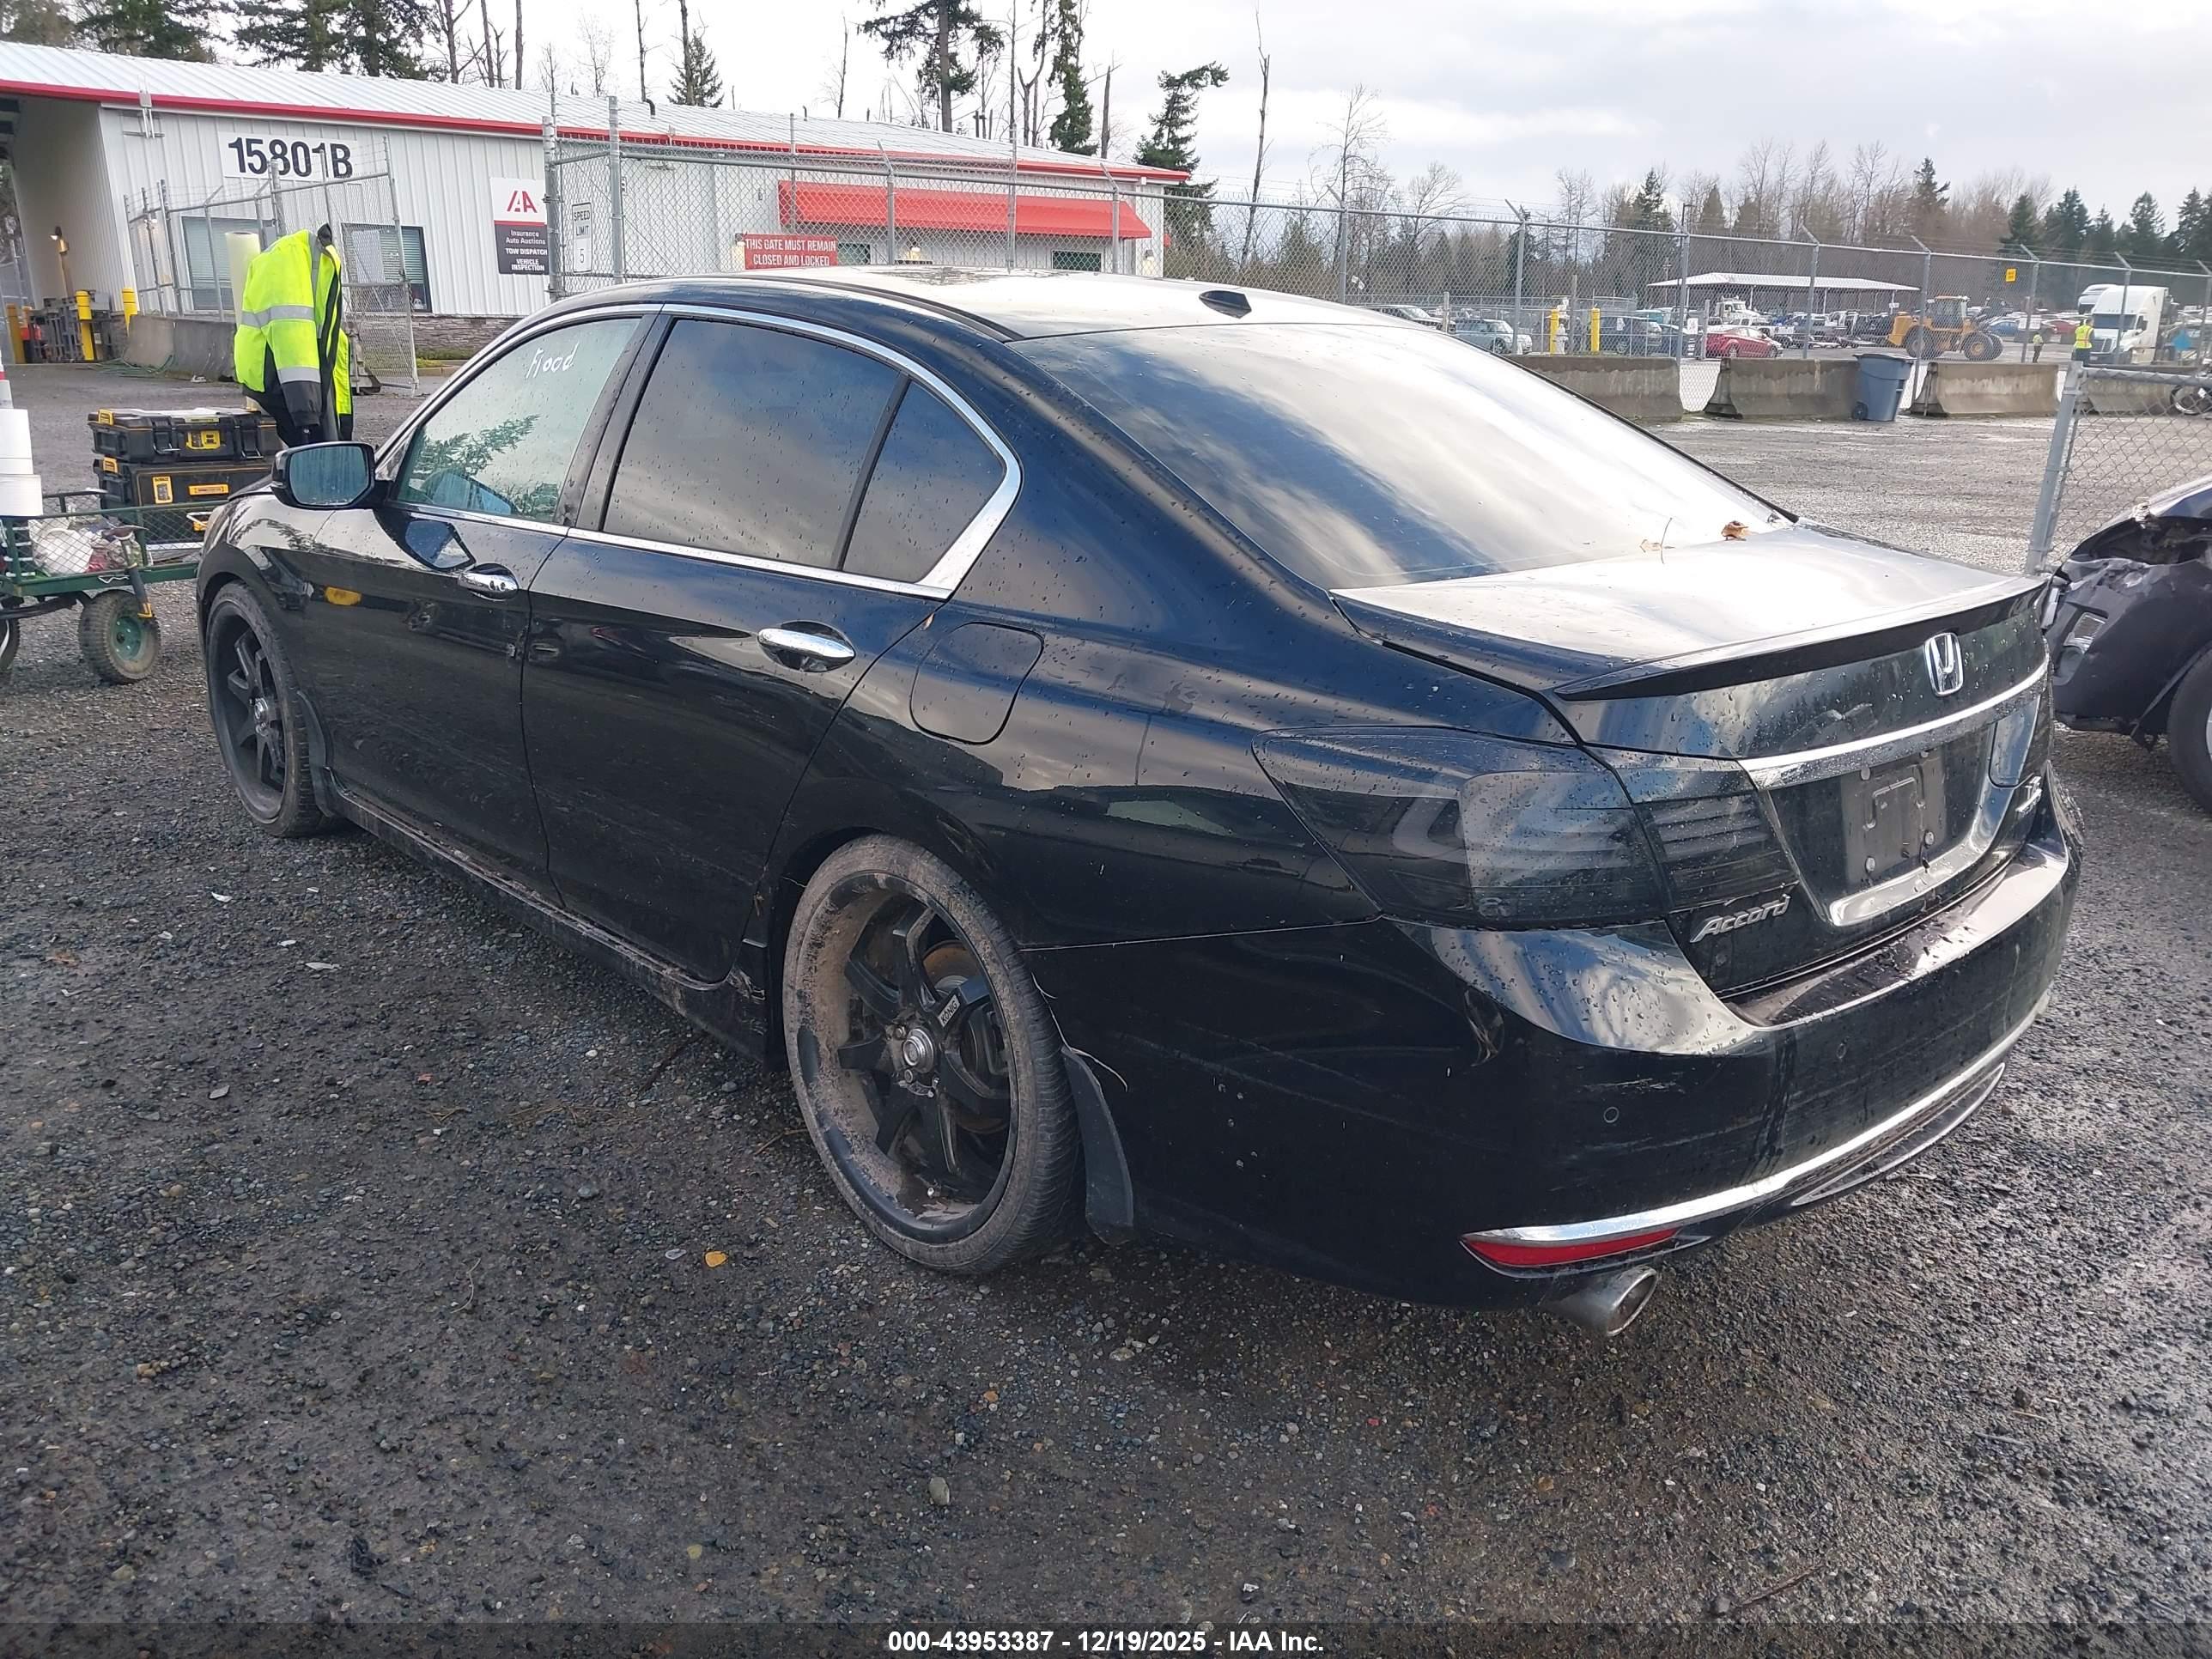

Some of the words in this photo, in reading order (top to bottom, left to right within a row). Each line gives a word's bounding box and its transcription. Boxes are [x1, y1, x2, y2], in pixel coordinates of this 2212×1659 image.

[228, 137, 354, 179] 15801B
[574, 210, 591, 222] SPEED
[576, 226, 589, 236] LIMIT
[745, 239, 763, 250] THIS
[764, 239, 784, 251] GATE
[785, 240, 806, 251] MUST
[807, 240, 836, 252] REMAIN
[580, 248, 585, 264] 5
[753, 254, 782, 265] CLOSED
[783, 254, 799, 265] AND
[801, 255, 830, 266] LOCKED
[1689, 893, 1791, 943] Accord
